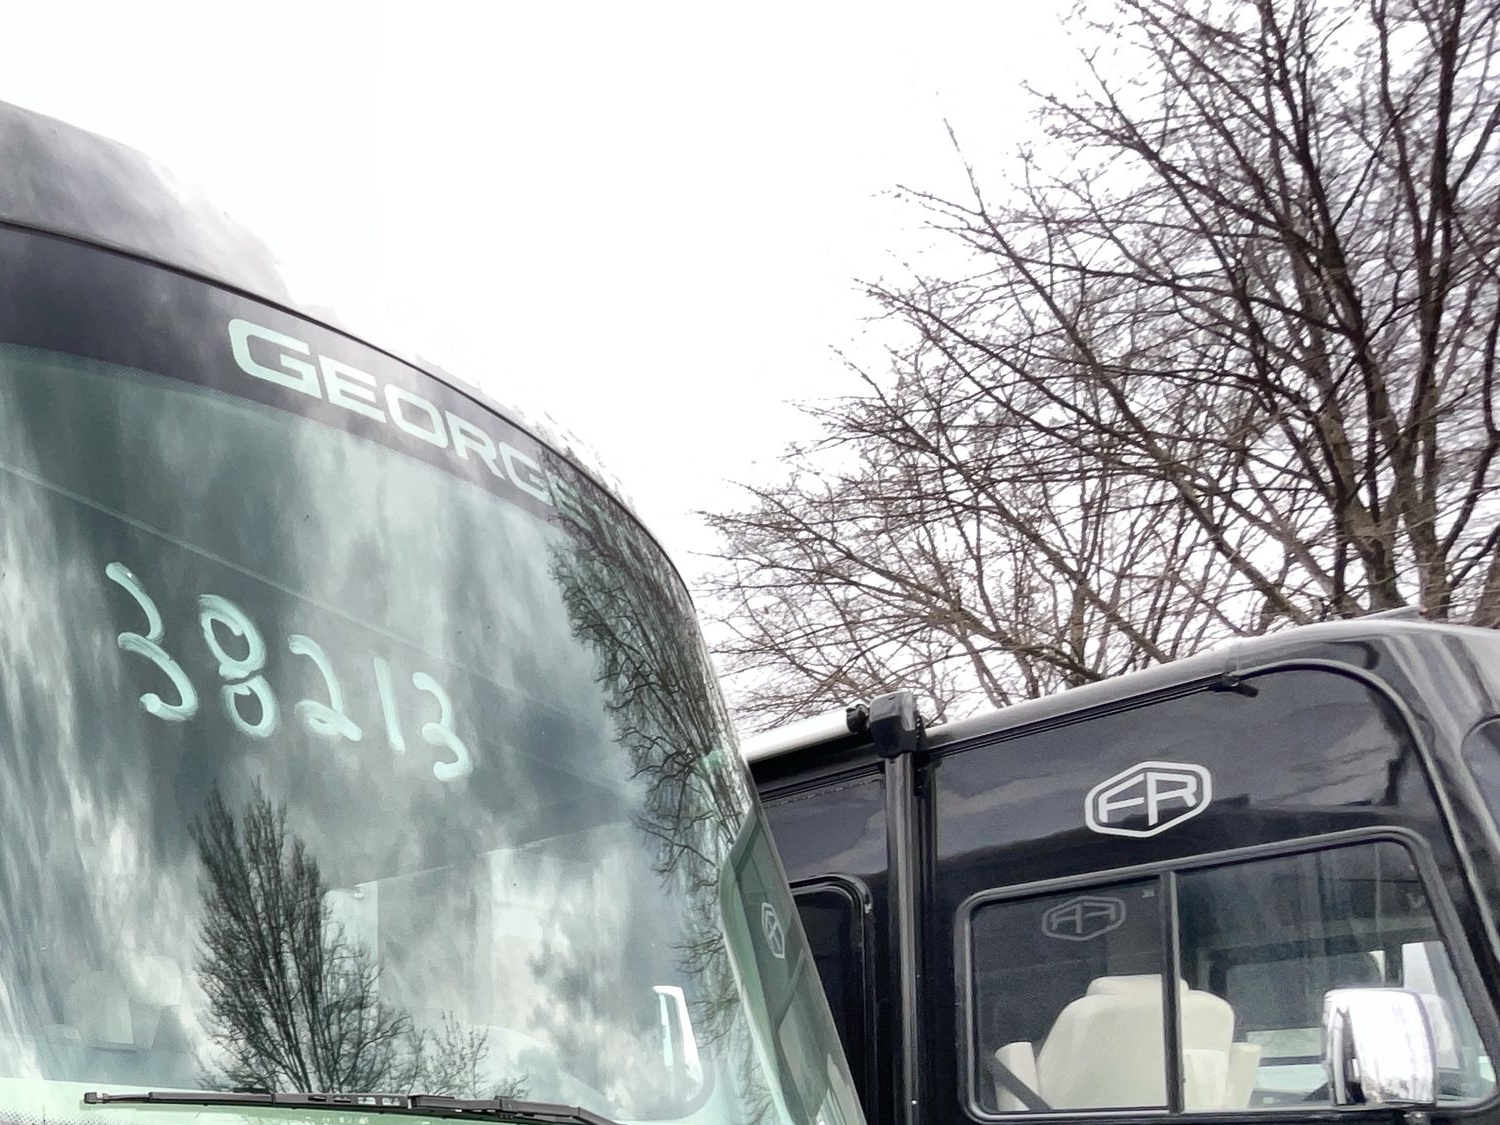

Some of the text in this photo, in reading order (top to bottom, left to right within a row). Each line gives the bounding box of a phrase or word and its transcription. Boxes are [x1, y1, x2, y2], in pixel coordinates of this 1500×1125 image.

[228, 318, 640, 570] GEORGE
[105, 562, 473, 781] 38213
[1097, 771, 1199, 827] FR
